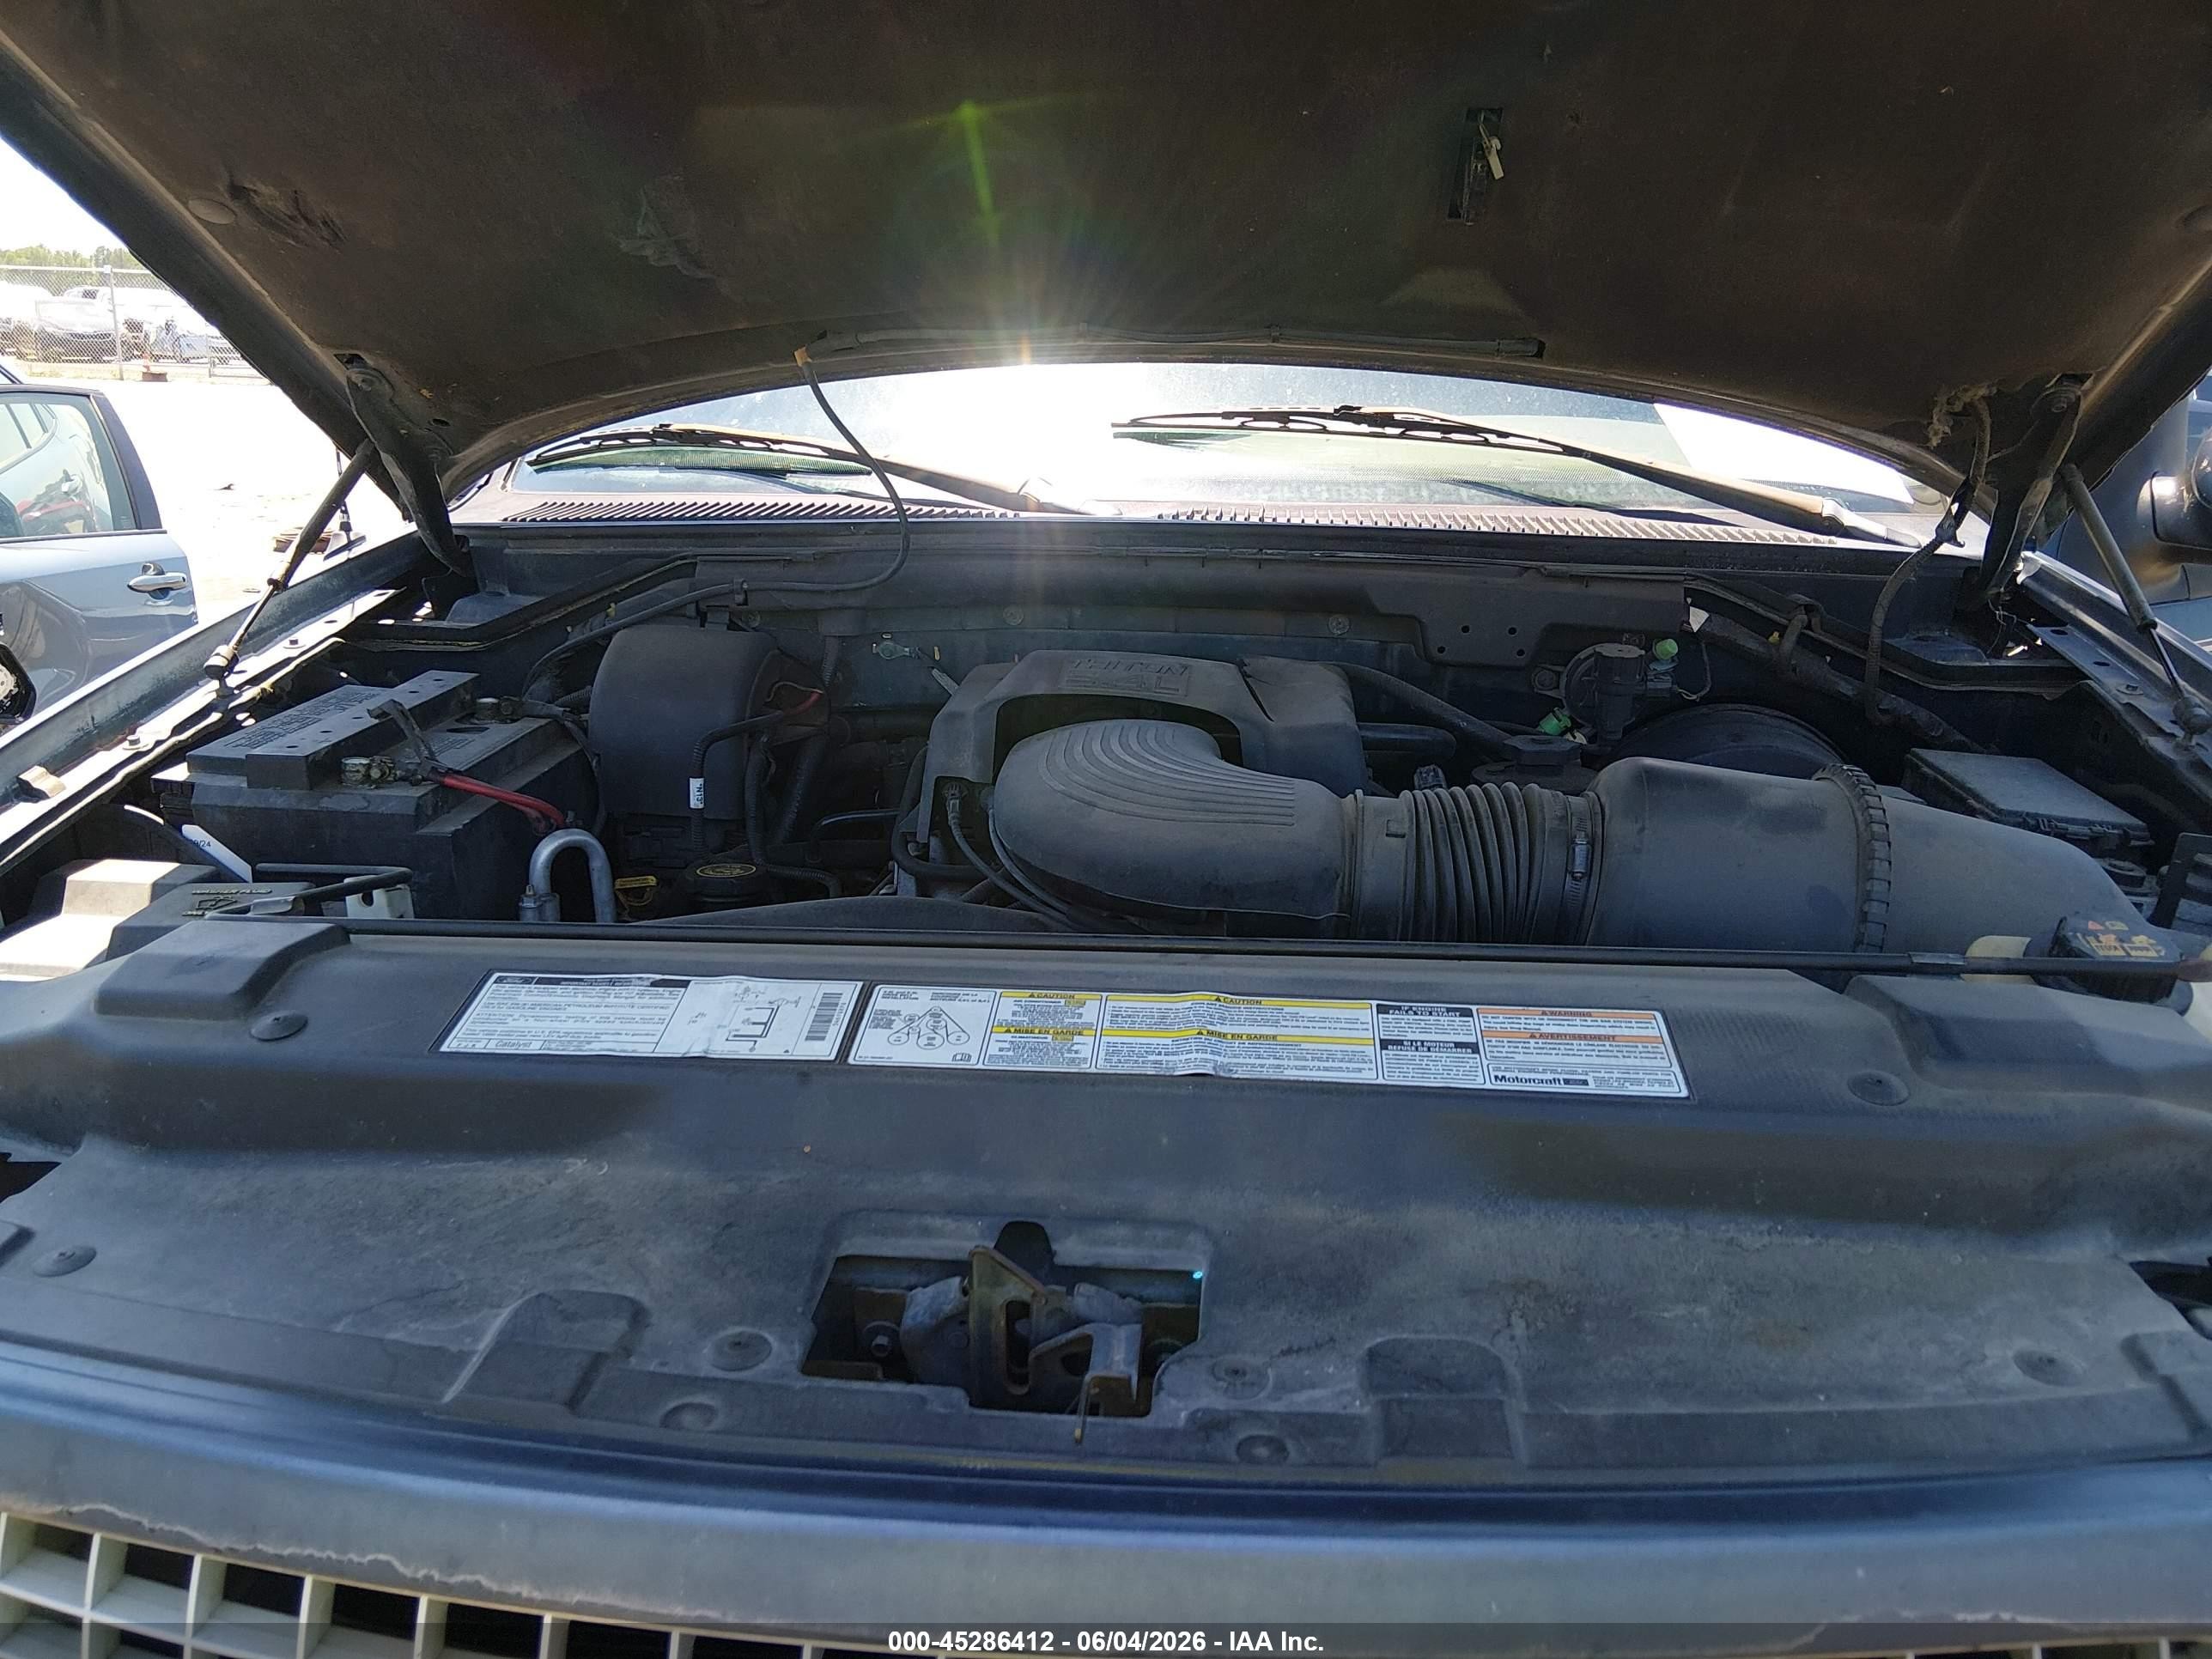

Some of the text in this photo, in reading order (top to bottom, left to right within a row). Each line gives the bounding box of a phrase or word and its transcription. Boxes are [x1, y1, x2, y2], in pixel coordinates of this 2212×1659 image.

[1206, 1030, 1229, 1038] MISE
[1538, 1032, 1616, 1041] AVERTISSEMENT
[495, 1040, 532, 1050] Catalyst
[1493, 1075, 1561, 1085] Motorcraft
